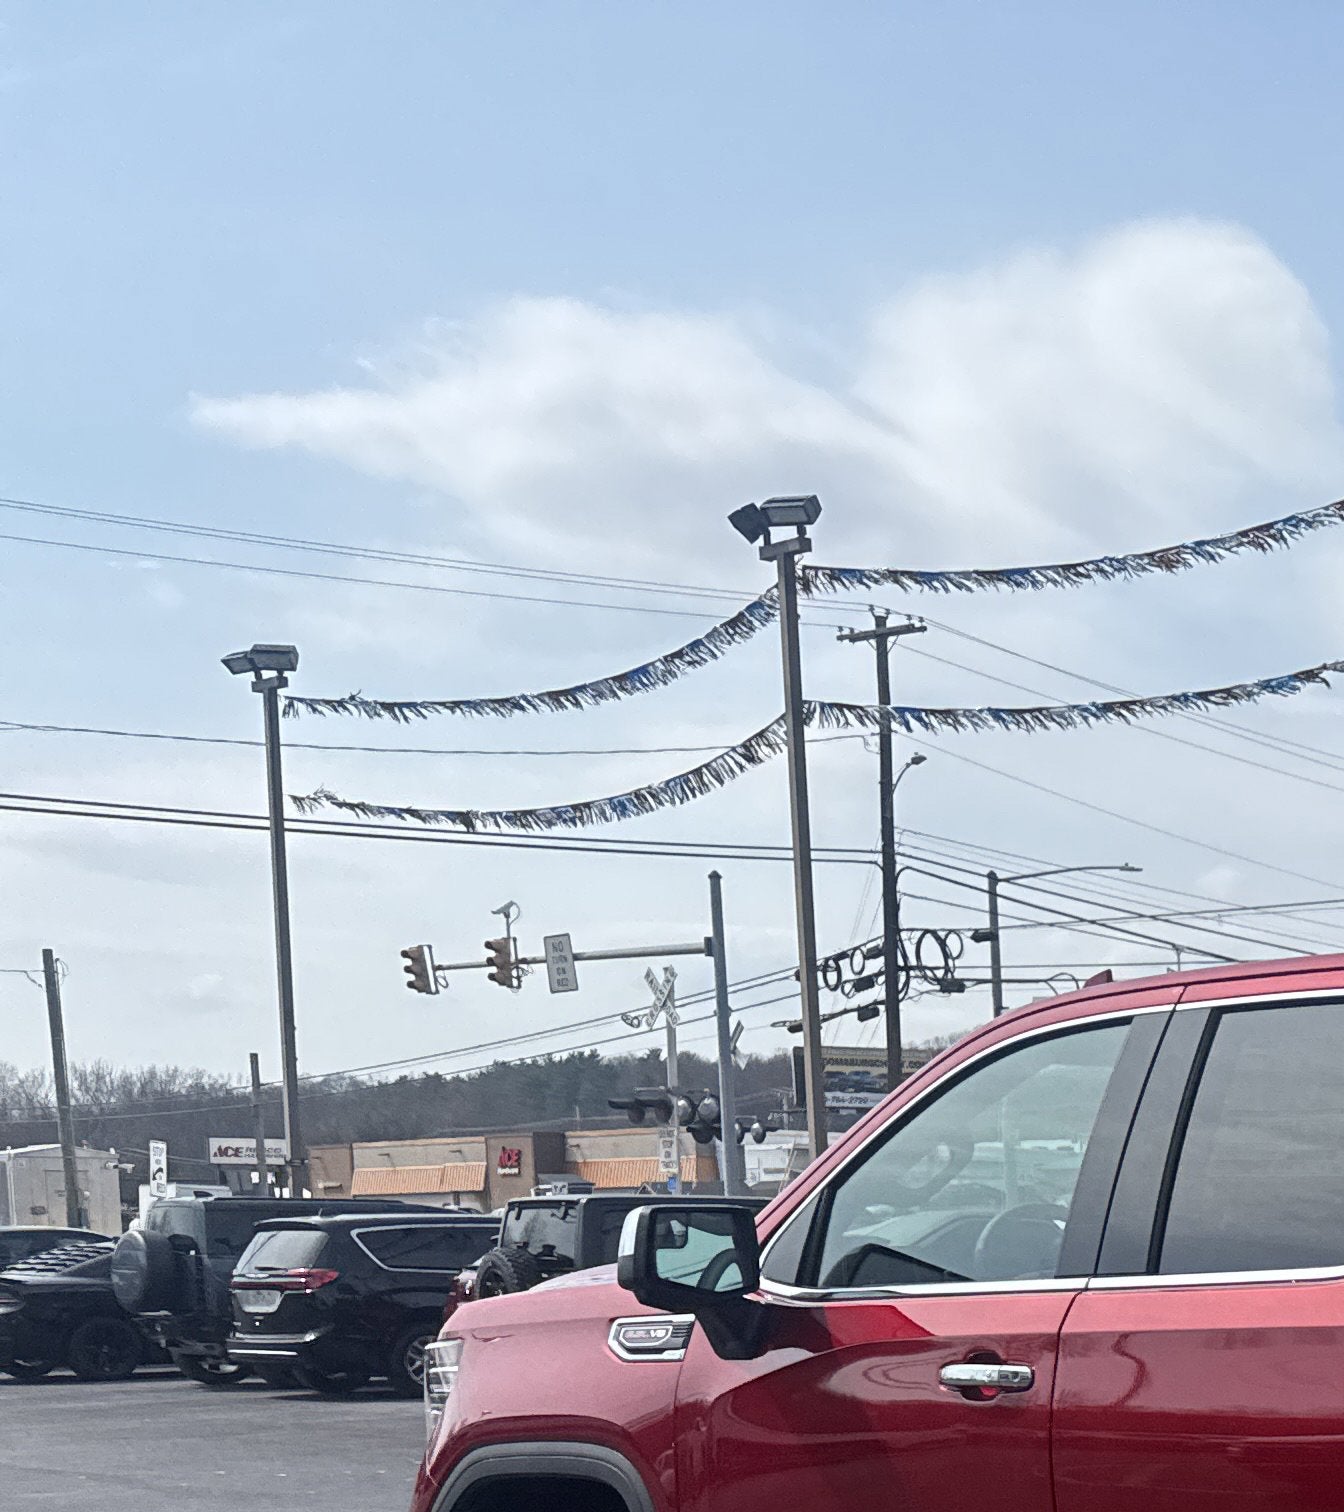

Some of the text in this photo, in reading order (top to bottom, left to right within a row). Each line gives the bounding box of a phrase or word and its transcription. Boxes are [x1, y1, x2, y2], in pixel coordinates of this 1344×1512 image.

[552, 940, 563, 953] NO
[552, 955, 568, 964] TURN
[556, 967, 567, 976] ON
[557, 977, 569, 987] RED
[213, 1145, 245, 1158] ACE
